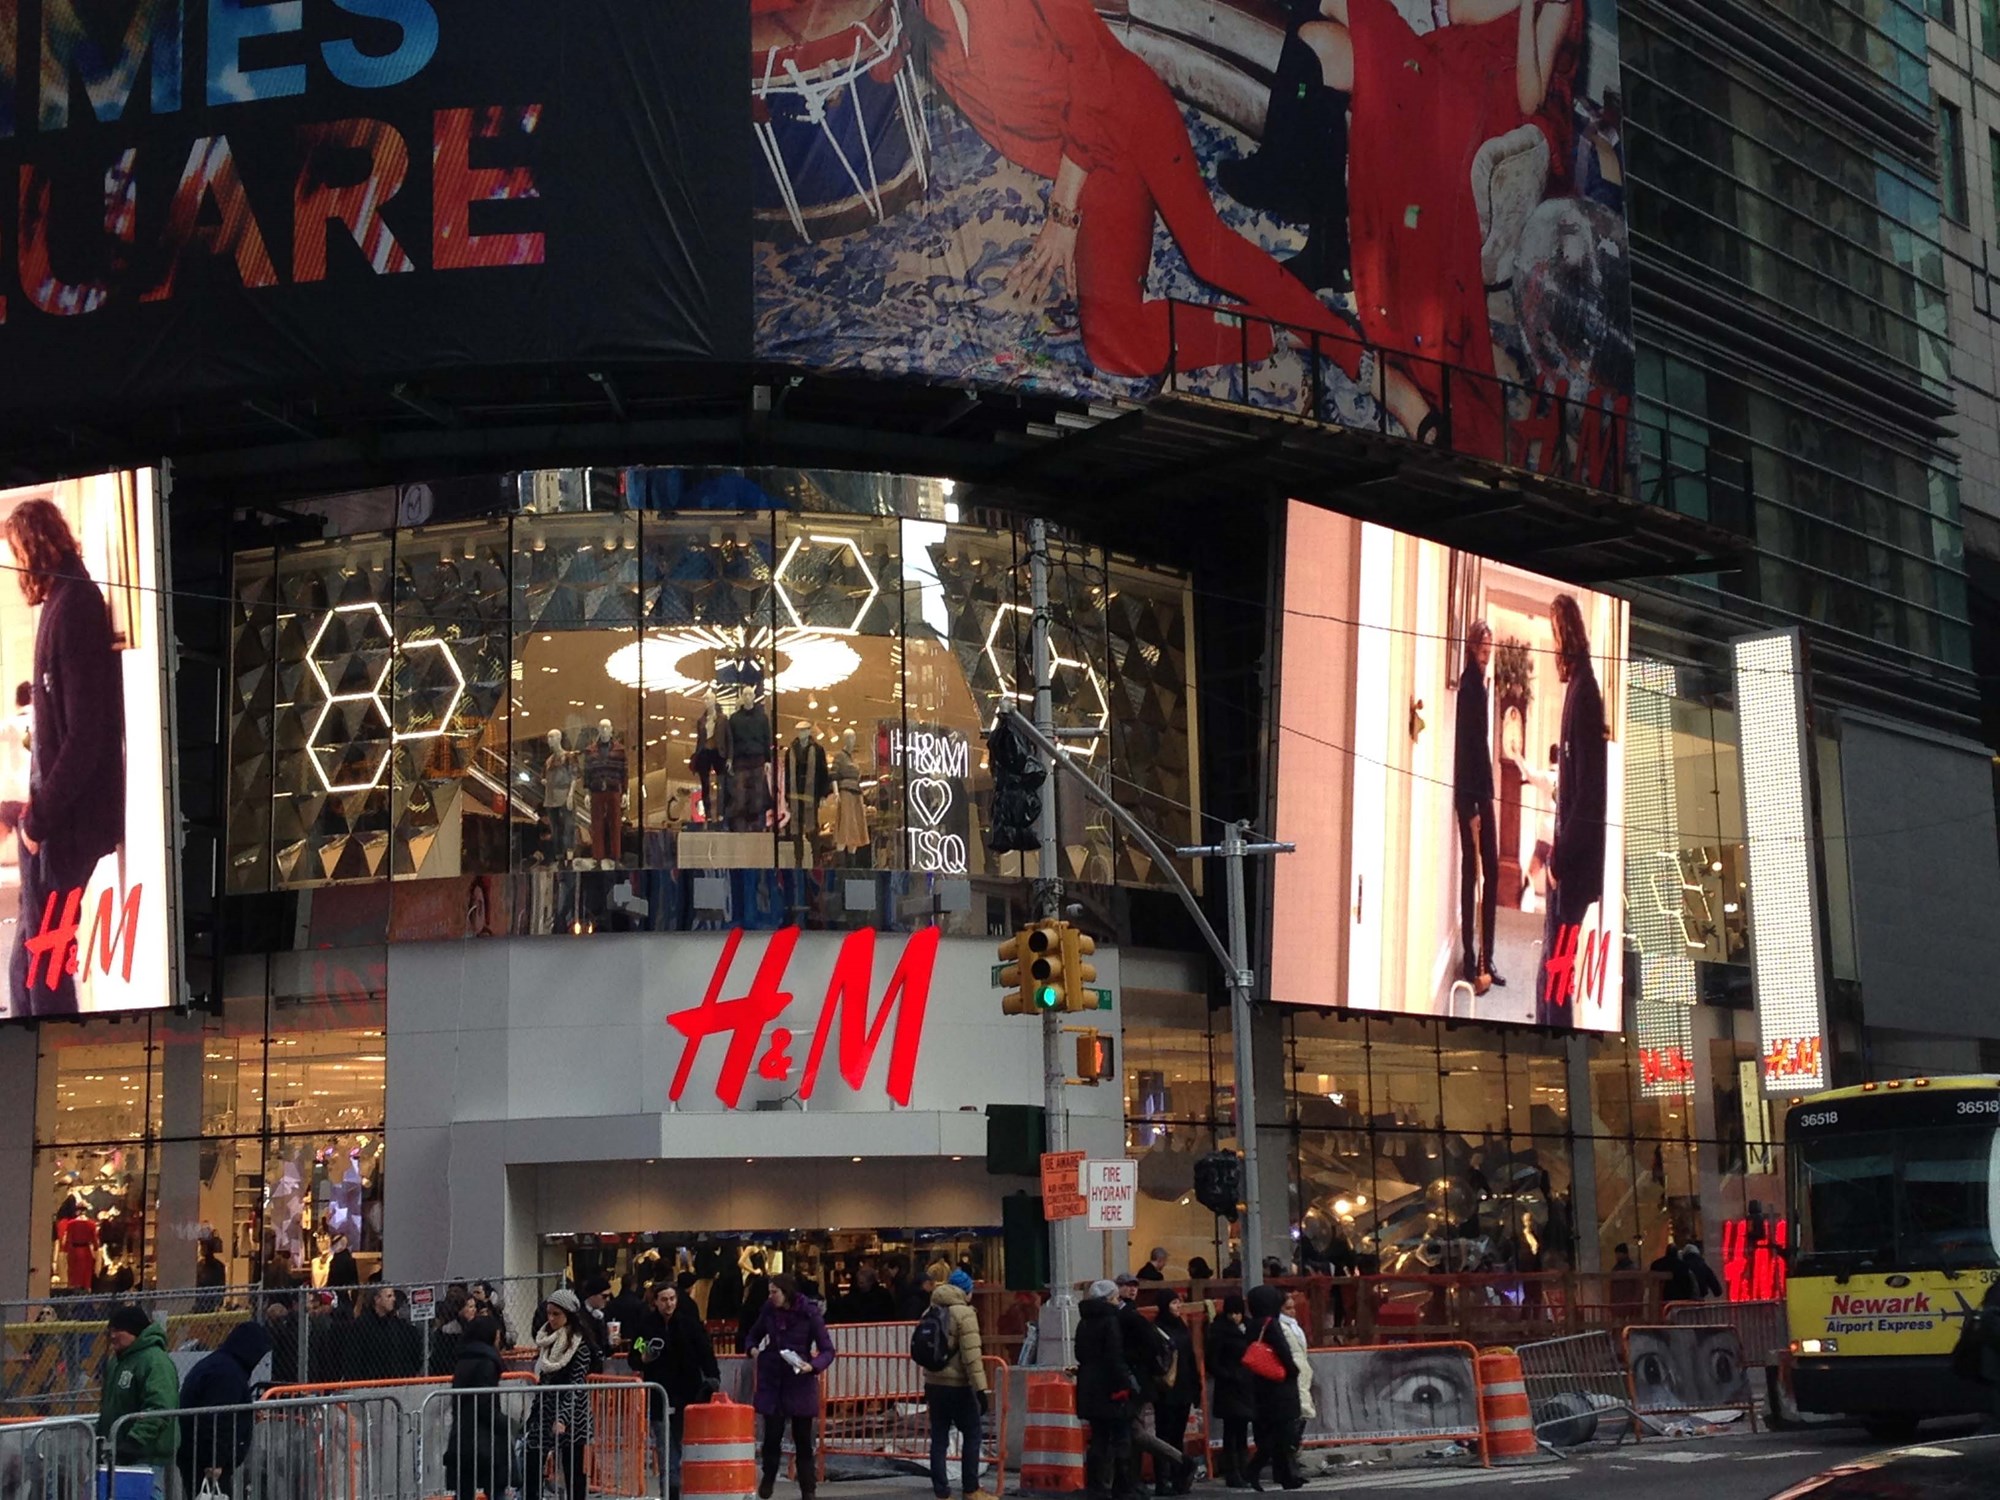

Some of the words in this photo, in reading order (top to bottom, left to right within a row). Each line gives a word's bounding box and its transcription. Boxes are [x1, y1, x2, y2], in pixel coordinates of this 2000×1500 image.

[0, 103, 546, 325] UARE
[907, 827, 968, 873] TSQ
[24, 882, 143, 991] H&M
[1544, 924, 1611, 1009] H&M
[666, 924, 941, 1109] H&M
[1956, 1100, 2000, 1114] 36518
[1801, 1111, 1839, 1127] 36518
[1103, 1166, 1121, 1182] FIRE
[1091, 1185, 1132, 1201] HYDRANT
[1101, 1205, 1122, 1221] HERE
[1831, 1292, 1932, 1316] Newark
[1826, 1320, 1874, 1334] Airport
[1877, 1318, 1933, 1333] Express
